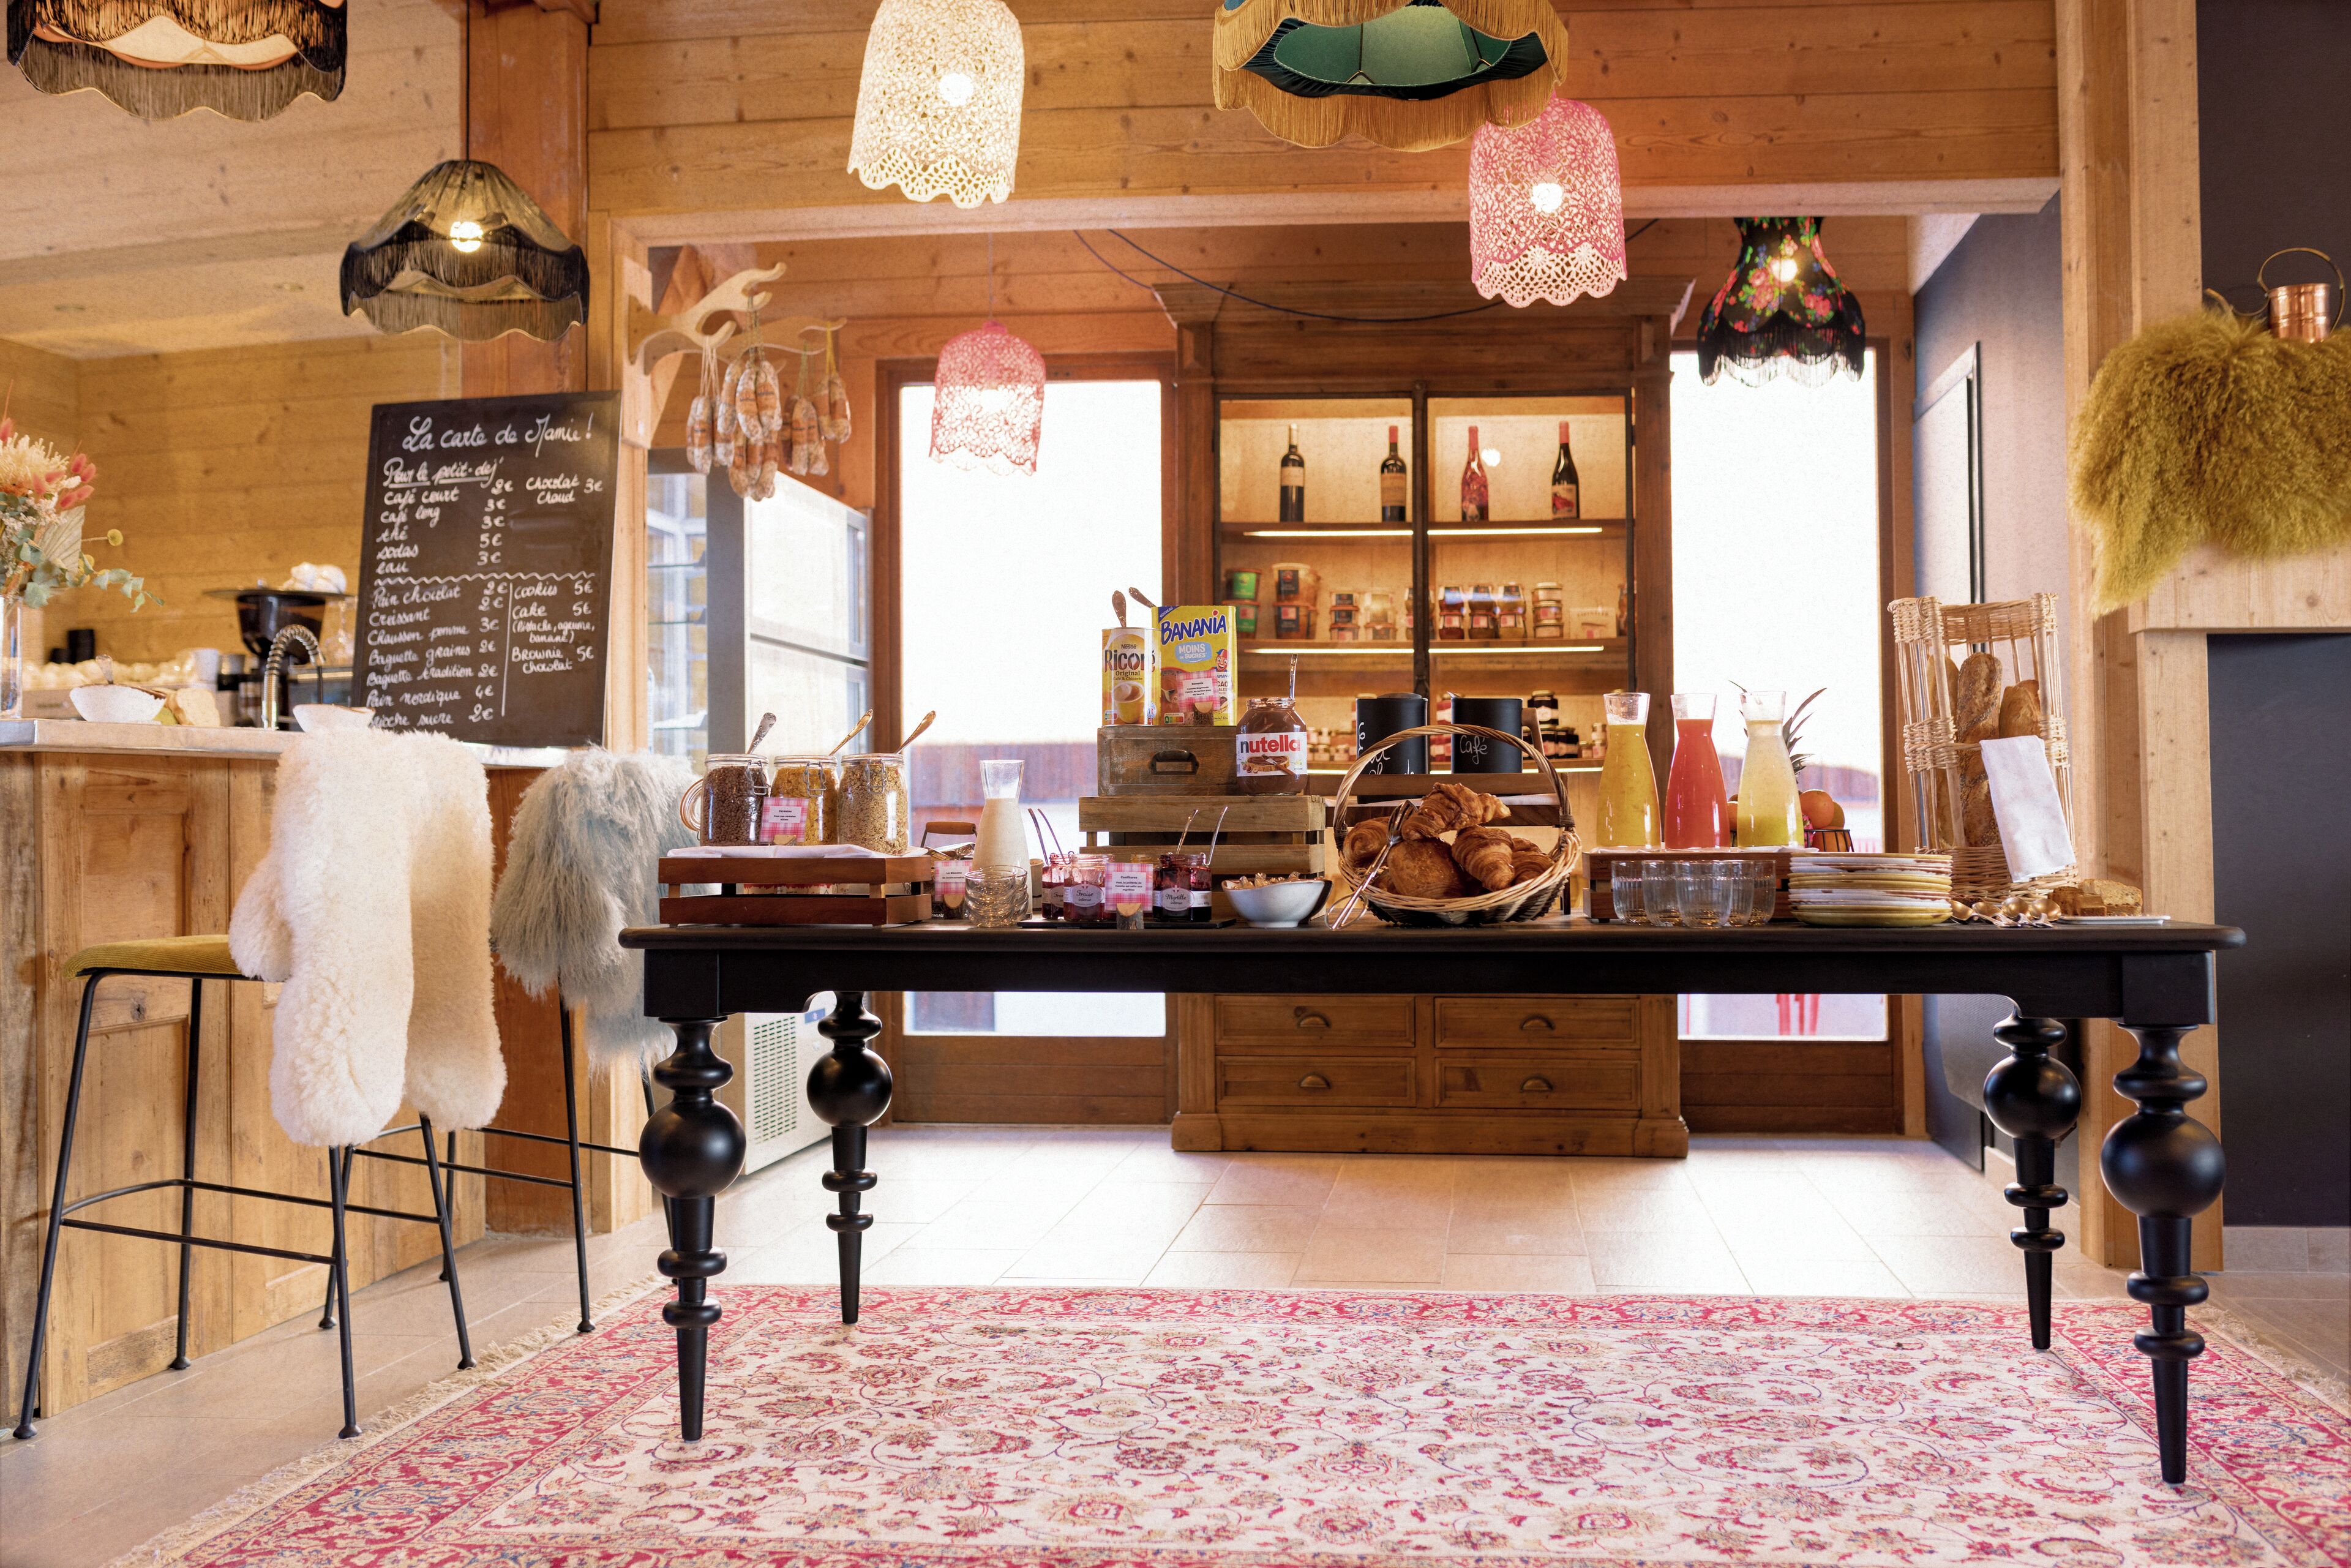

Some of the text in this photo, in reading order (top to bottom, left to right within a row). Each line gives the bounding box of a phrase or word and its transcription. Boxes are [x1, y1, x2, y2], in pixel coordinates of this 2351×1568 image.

[402, 416, 435, 452] La
[440, 423, 488, 448] carte
[495, 423, 518, 445] de
[525, 413, 581, 458] Mamie
[383, 457, 414, 487] Pour
[416, 460, 429, 481] le
[421, 486, 460, 504] court
[583, 478, 603, 493] 3€
[415, 505, 441, 528] long
[484, 498, 506, 512] 3€
[375, 516, 506, 543] thé 3€
[376, 533, 503, 560] sodas 5€
[375, 551, 502, 576] eau 3€
[372, 580, 509, 609] Pain chocolat 2€
[574, 579, 593, 595] 5€
[369, 596, 504, 626] Croissant 2€
[572, 601, 592, 617] 5€
[1159, 606, 1174, 618] NOUVEAU
[367, 617, 500, 645] Chausson pomme 3€
[369, 639, 497, 673] Baguette graines 2€
[511, 645, 594, 662] Brownie 5€
[1179, 643, 1206, 654] MOINS
[366, 663, 498, 691] Baguette tradition 2€
[366, 684, 495, 708] Pain nordique 4€
[368, 711, 411, 728] rioche
[468, 703, 494, 722] 2€
[1240, 734, 1300, 754] nutella
[1460, 735, 1490, 764] Café
